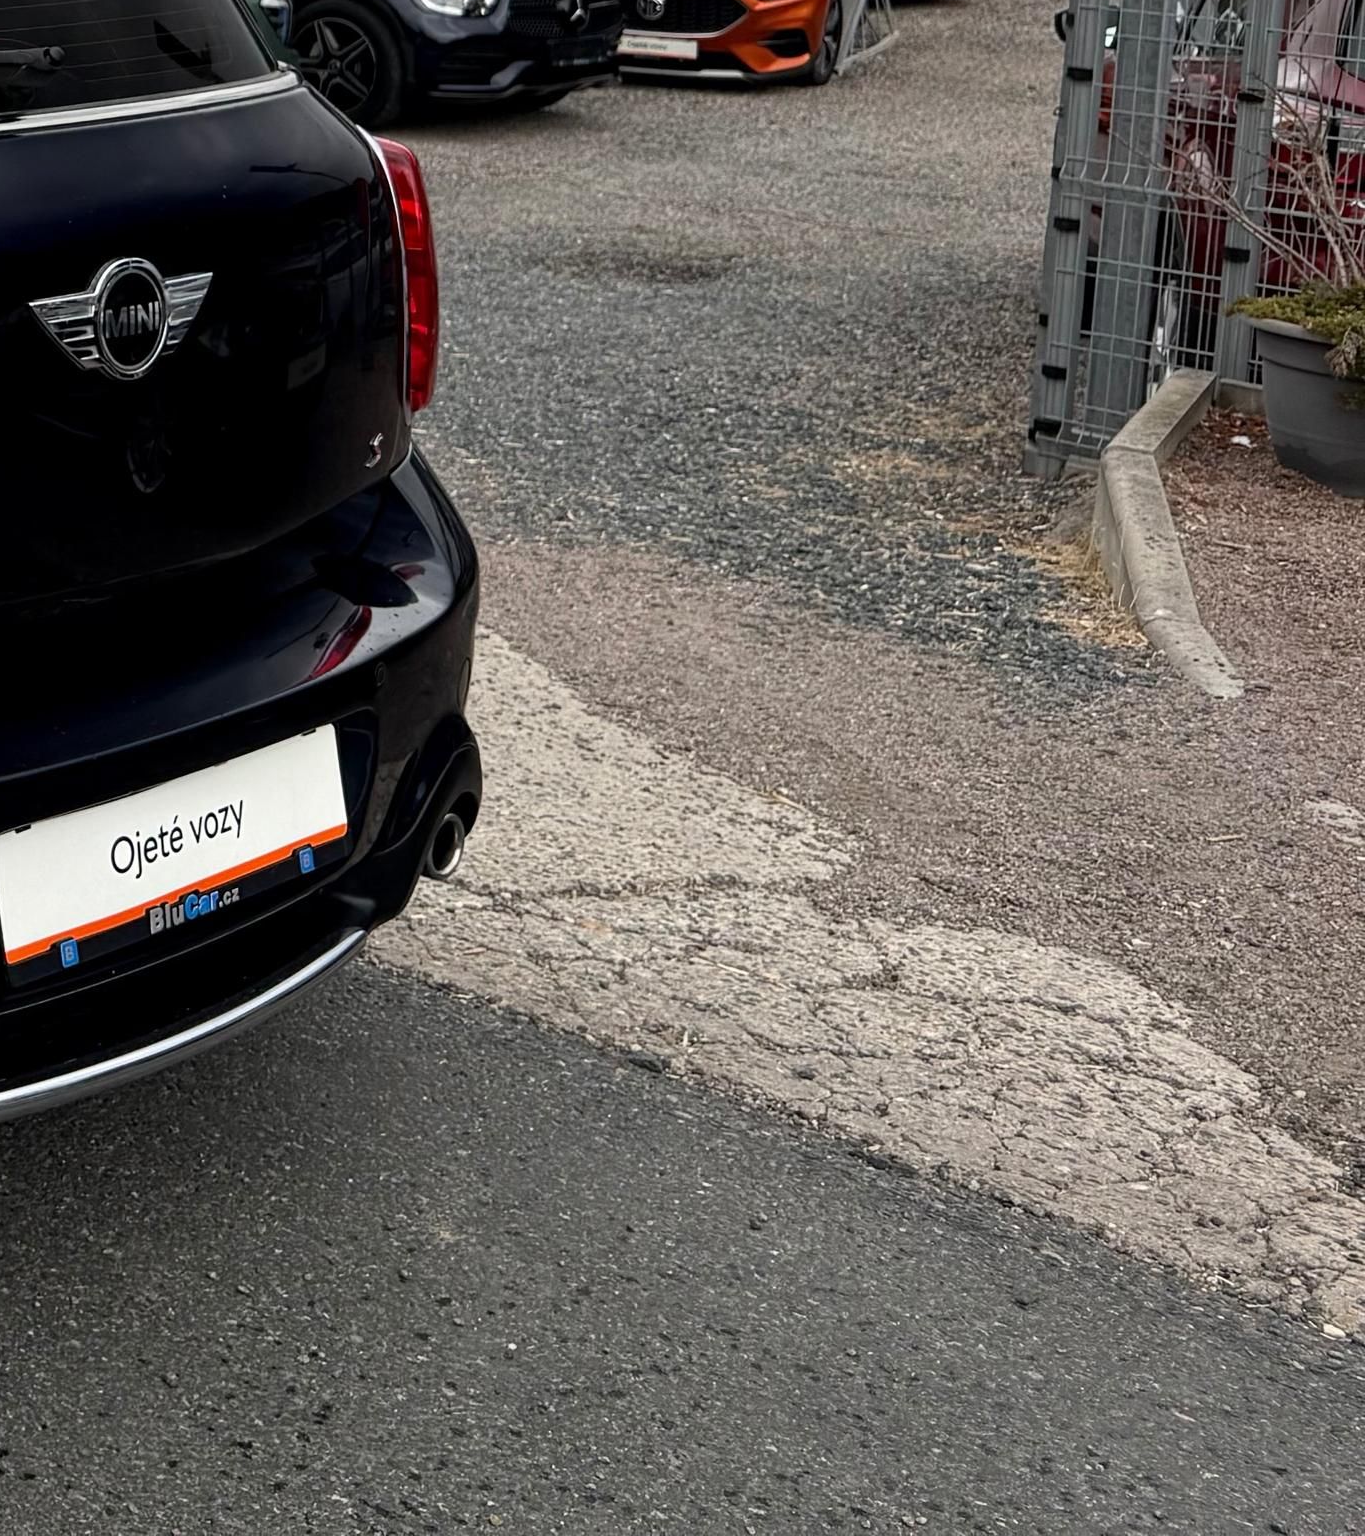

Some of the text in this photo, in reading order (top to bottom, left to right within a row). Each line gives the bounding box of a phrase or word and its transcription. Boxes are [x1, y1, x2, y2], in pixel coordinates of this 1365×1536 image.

[105, 301, 159, 339] MINI
[110, 799, 244, 879] Ojeté vozy
[149, 886, 241, 935] BluCar.cz
